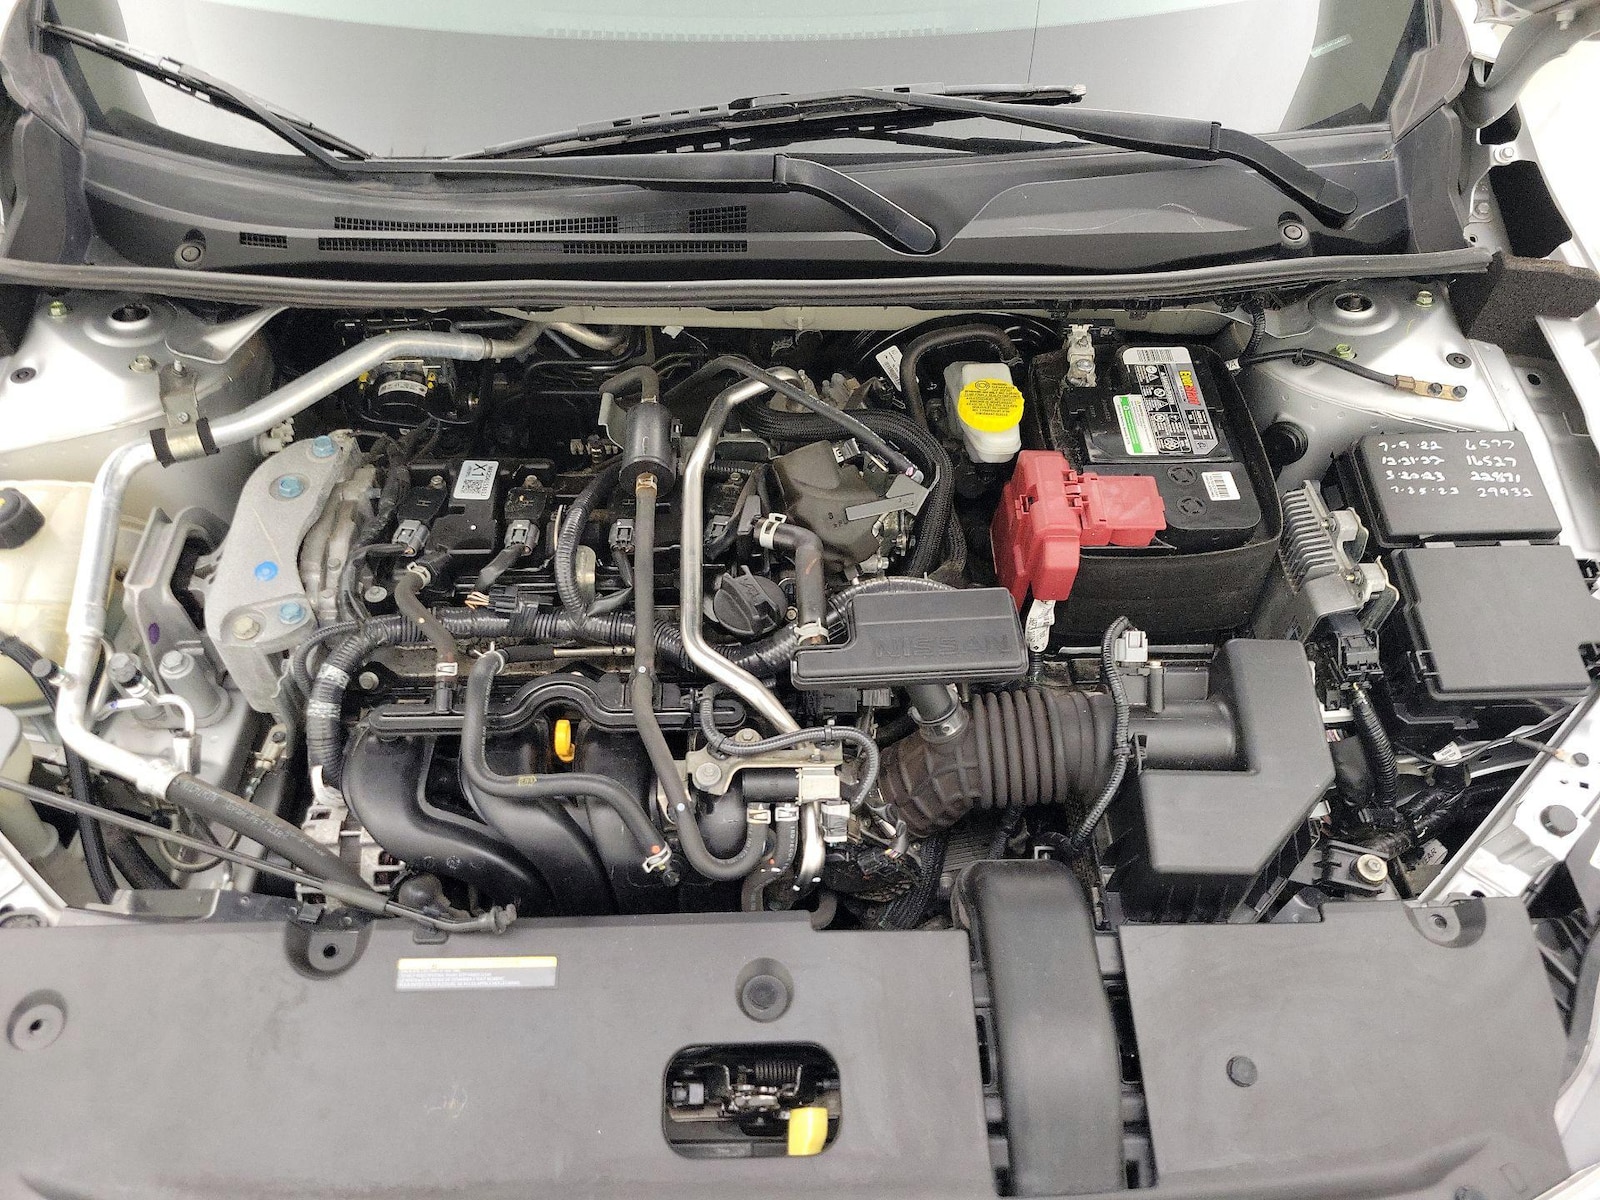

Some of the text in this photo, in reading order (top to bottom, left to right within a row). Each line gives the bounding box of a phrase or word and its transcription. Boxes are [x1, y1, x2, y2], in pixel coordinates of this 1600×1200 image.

[1179, 371, 1201, 405] EverStart
[1466, 455, 1517, 467] 16527
[471, 463, 488, 477] X1
[1477, 487, 1533, 498] 29932
[877, 634, 1011, 659] NISSAN
